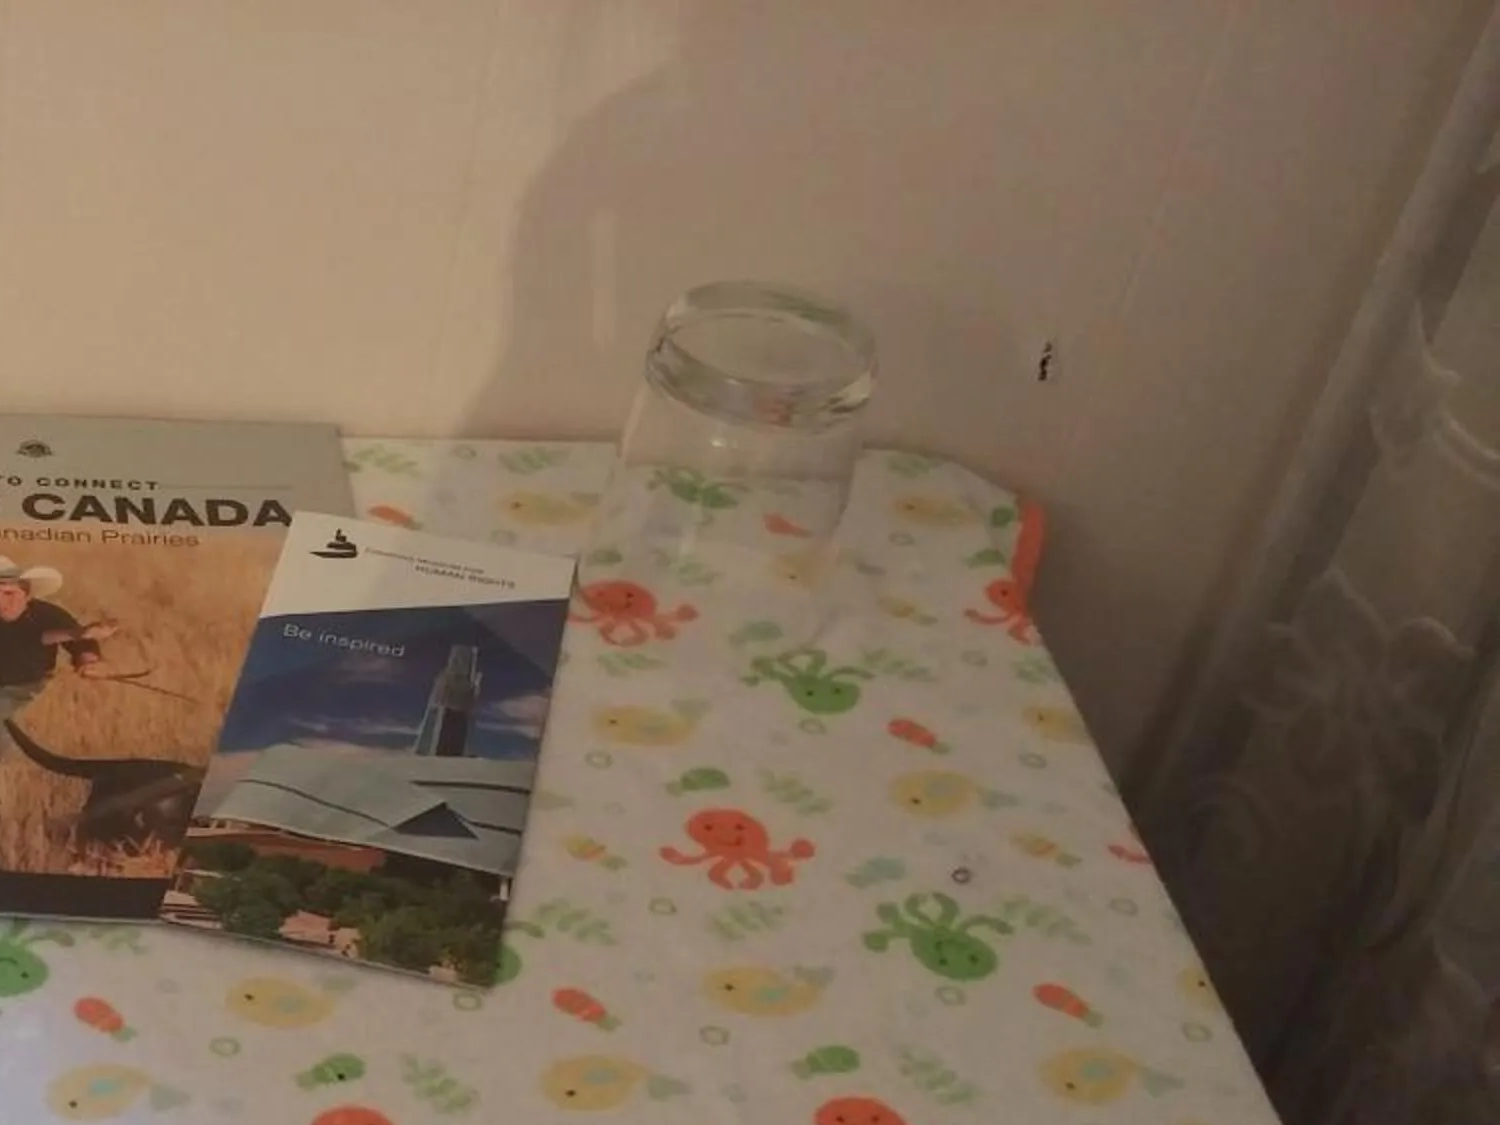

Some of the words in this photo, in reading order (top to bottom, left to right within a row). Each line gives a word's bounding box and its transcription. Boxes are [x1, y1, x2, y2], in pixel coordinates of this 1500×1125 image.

[35, 476, 159, 491] CONNECT
[21, 493, 293, 527] CANADA
[100, 528, 200, 548] Prairies
[283, 623, 312, 641] Be
[318, 629, 406, 657] inspired
